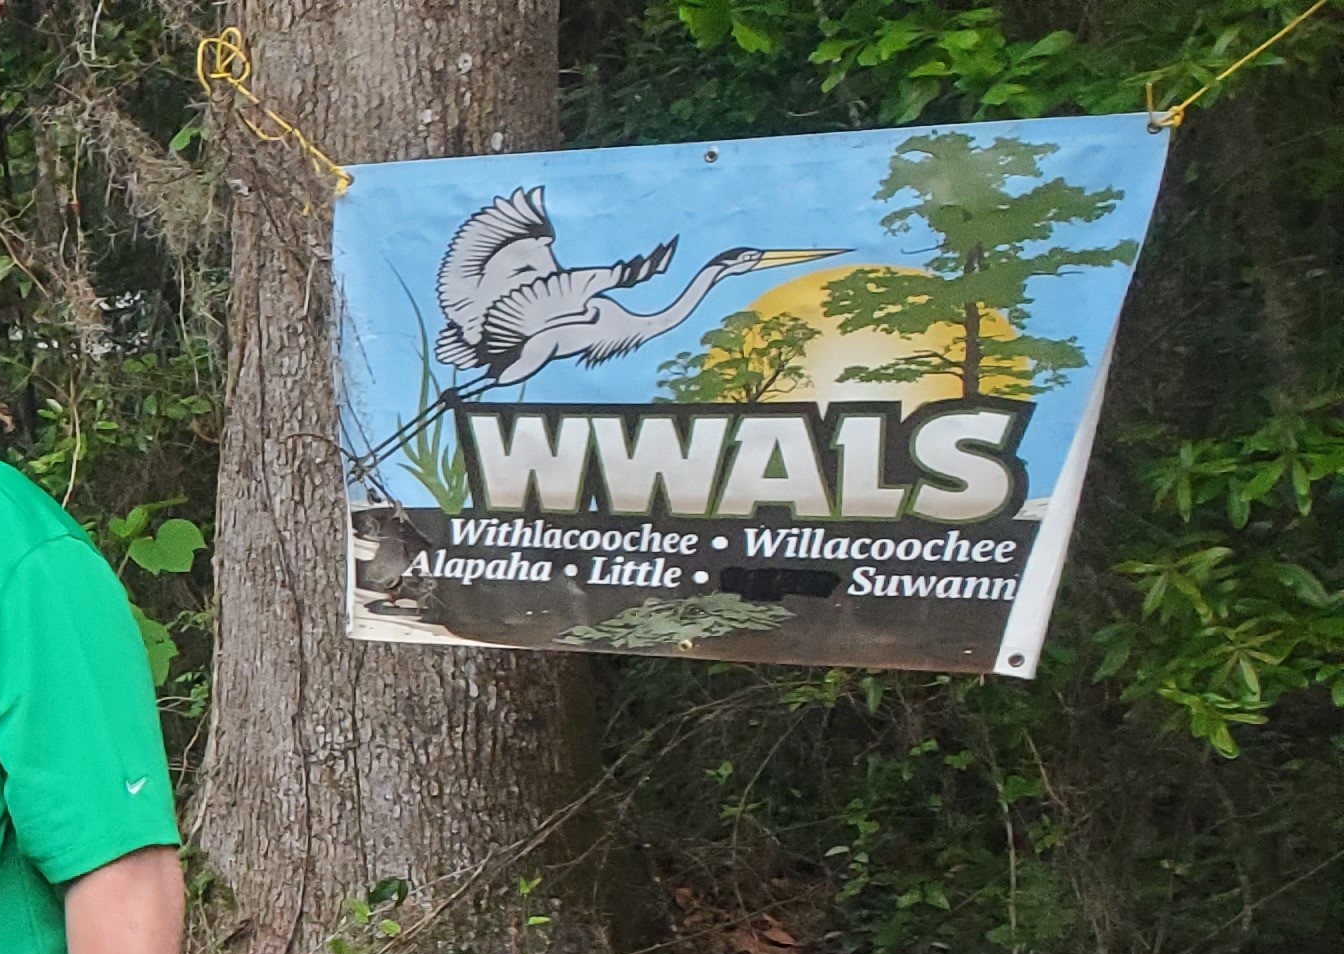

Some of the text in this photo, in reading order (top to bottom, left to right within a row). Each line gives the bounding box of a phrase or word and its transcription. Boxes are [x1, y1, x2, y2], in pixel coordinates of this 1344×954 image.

[468, 409, 1013, 522] WWALS
[449, 517, 1017, 563] Withlacoochee Willacoochee
[401, 549, 1019, 601] Alapaha Little Suwann
